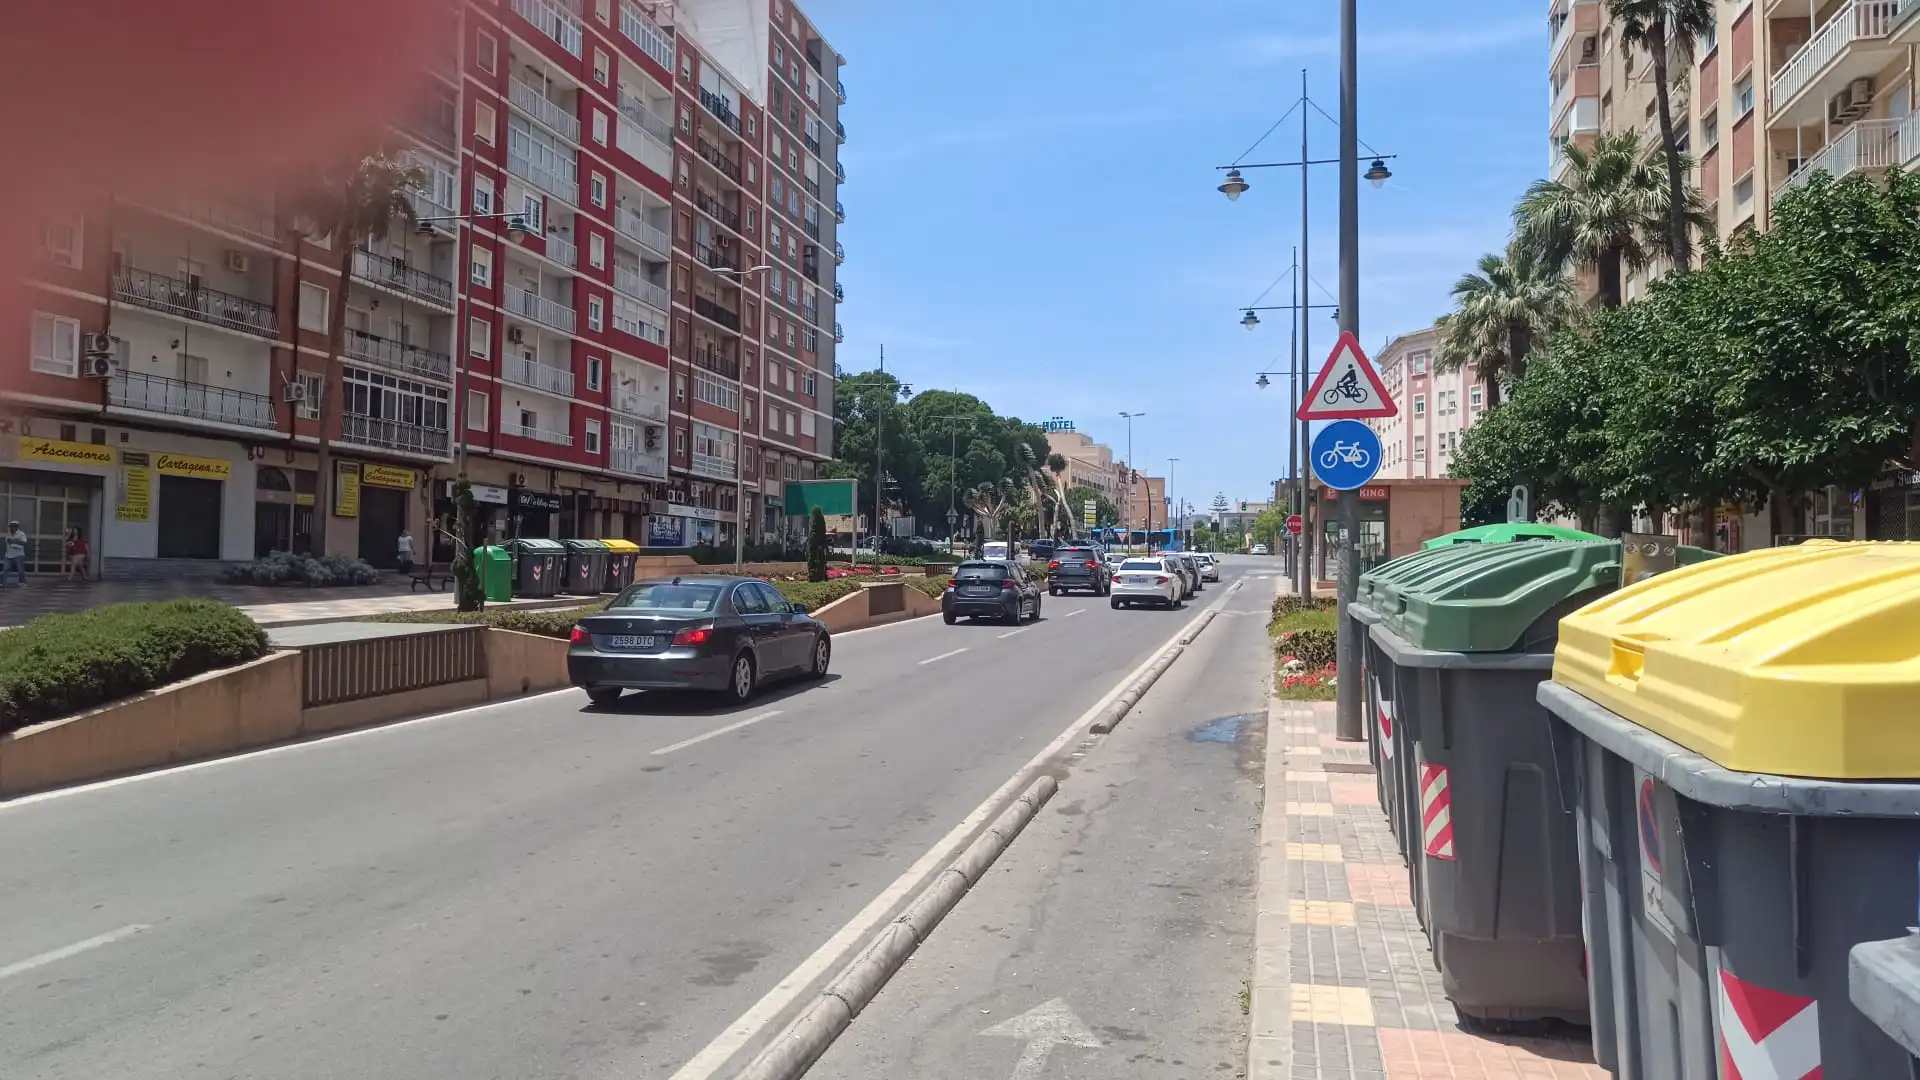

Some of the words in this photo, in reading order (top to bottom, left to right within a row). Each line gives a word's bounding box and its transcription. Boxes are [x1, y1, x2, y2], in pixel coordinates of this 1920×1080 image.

[1042, 421, 1076, 431] HOTEL
[32, 442, 112, 463] Ascensores
[1359, 488, 1385, 497] KING
[614, 636, 634, 645] 2598
[636, 635, 653, 645] DTC
